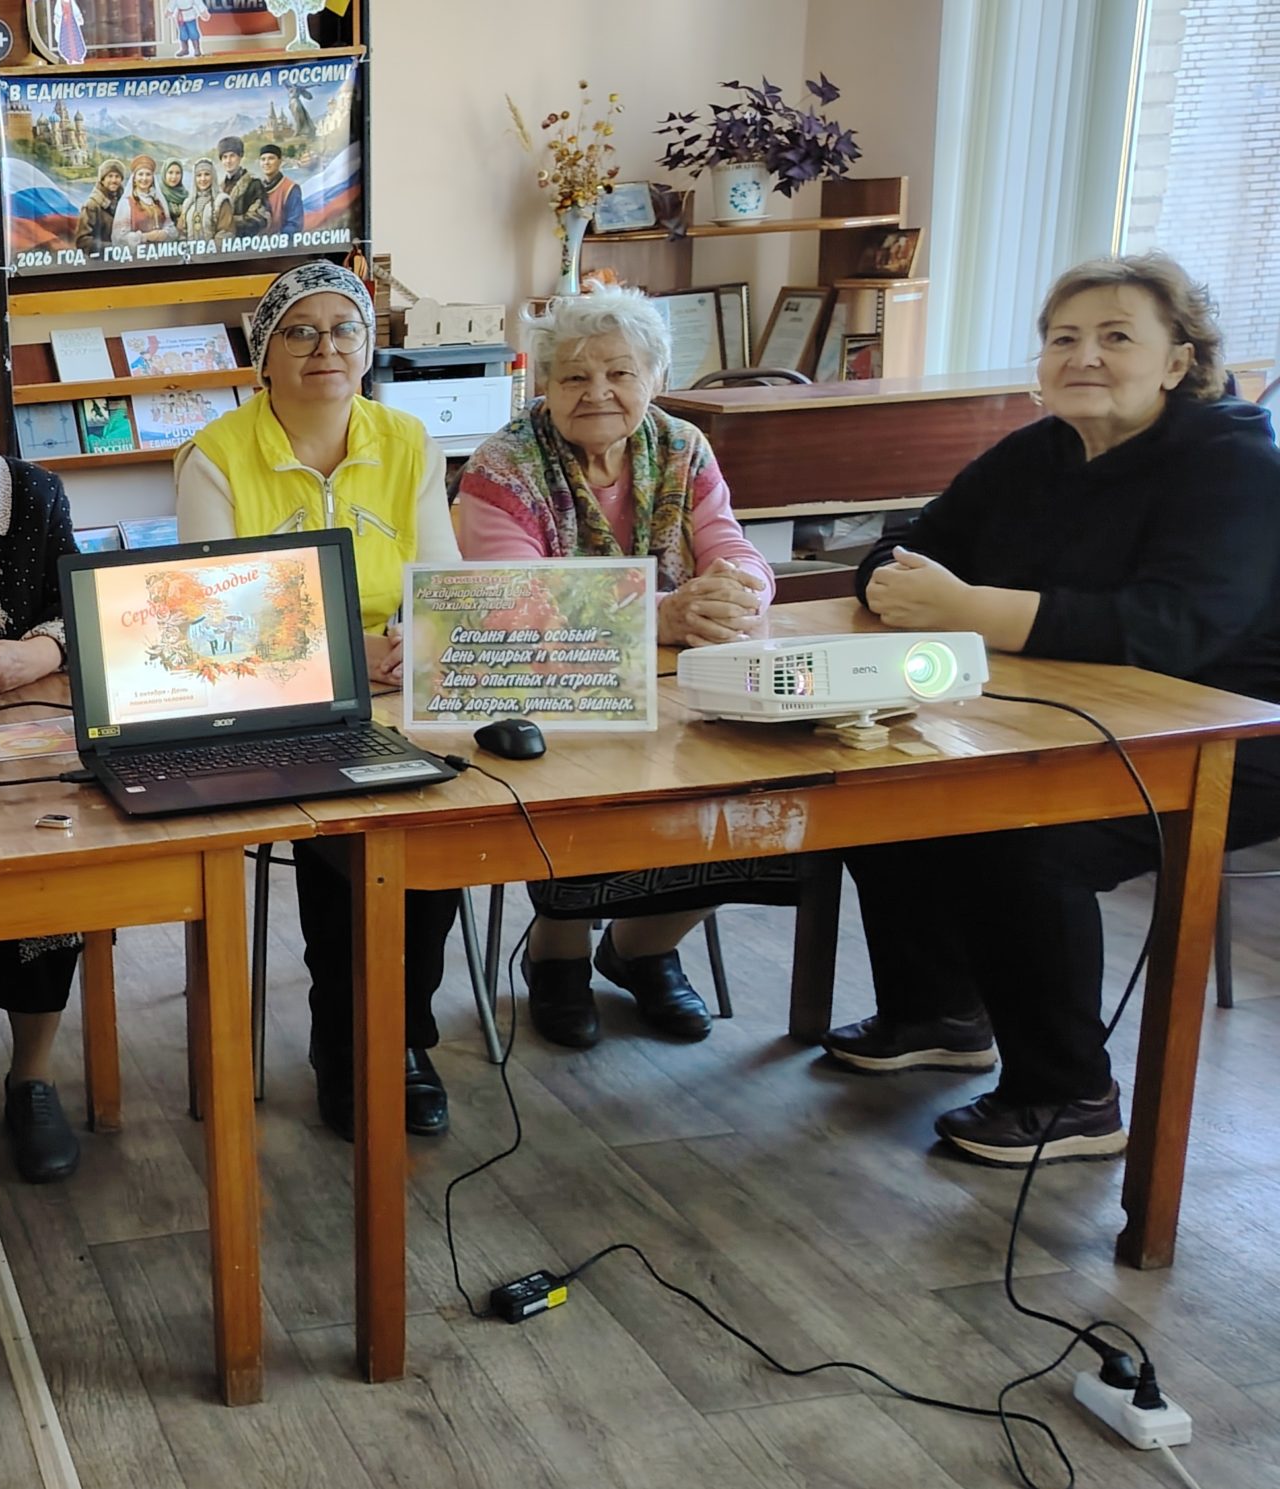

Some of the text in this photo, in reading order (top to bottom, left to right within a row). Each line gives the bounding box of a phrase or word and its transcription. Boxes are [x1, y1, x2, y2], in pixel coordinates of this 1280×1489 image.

[9, 84, 21, 101] В
[26, 81, 118, 103] ЕДИНСТВЕ
[123, 78, 203, 97] НАРОДОВ
[224, 72, 271, 89] СИЛА
[17, 251, 52, 267] 2026
[57, 248, 86, 266] ГОД
[104, 245, 133, 263] ГОД
[137, 239, 217, 262] ЕДИНСТВА
[221, 233, 288, 252] НАРОДОВ
[293, 228, 351, 247] РОССИИ
[204, 569, 260, 598] олодые
[431, 601, 479, 611] пожилых
[450, 627, 505, 643] Сегодня
[507, 631, 539, 643] день
[544, 627, 597, 643] особый
[440, 648, 475, 663] День
[477, 650, 533, 666] мудрых
[536, 650, 545, 662] и
[442, 670, 477, 687] День
[481, 674, 543, 687] опытных
[546, 674, 556, 686] и
[427, 694, 462, 711] День
[213, 717, 236, 727] acer
